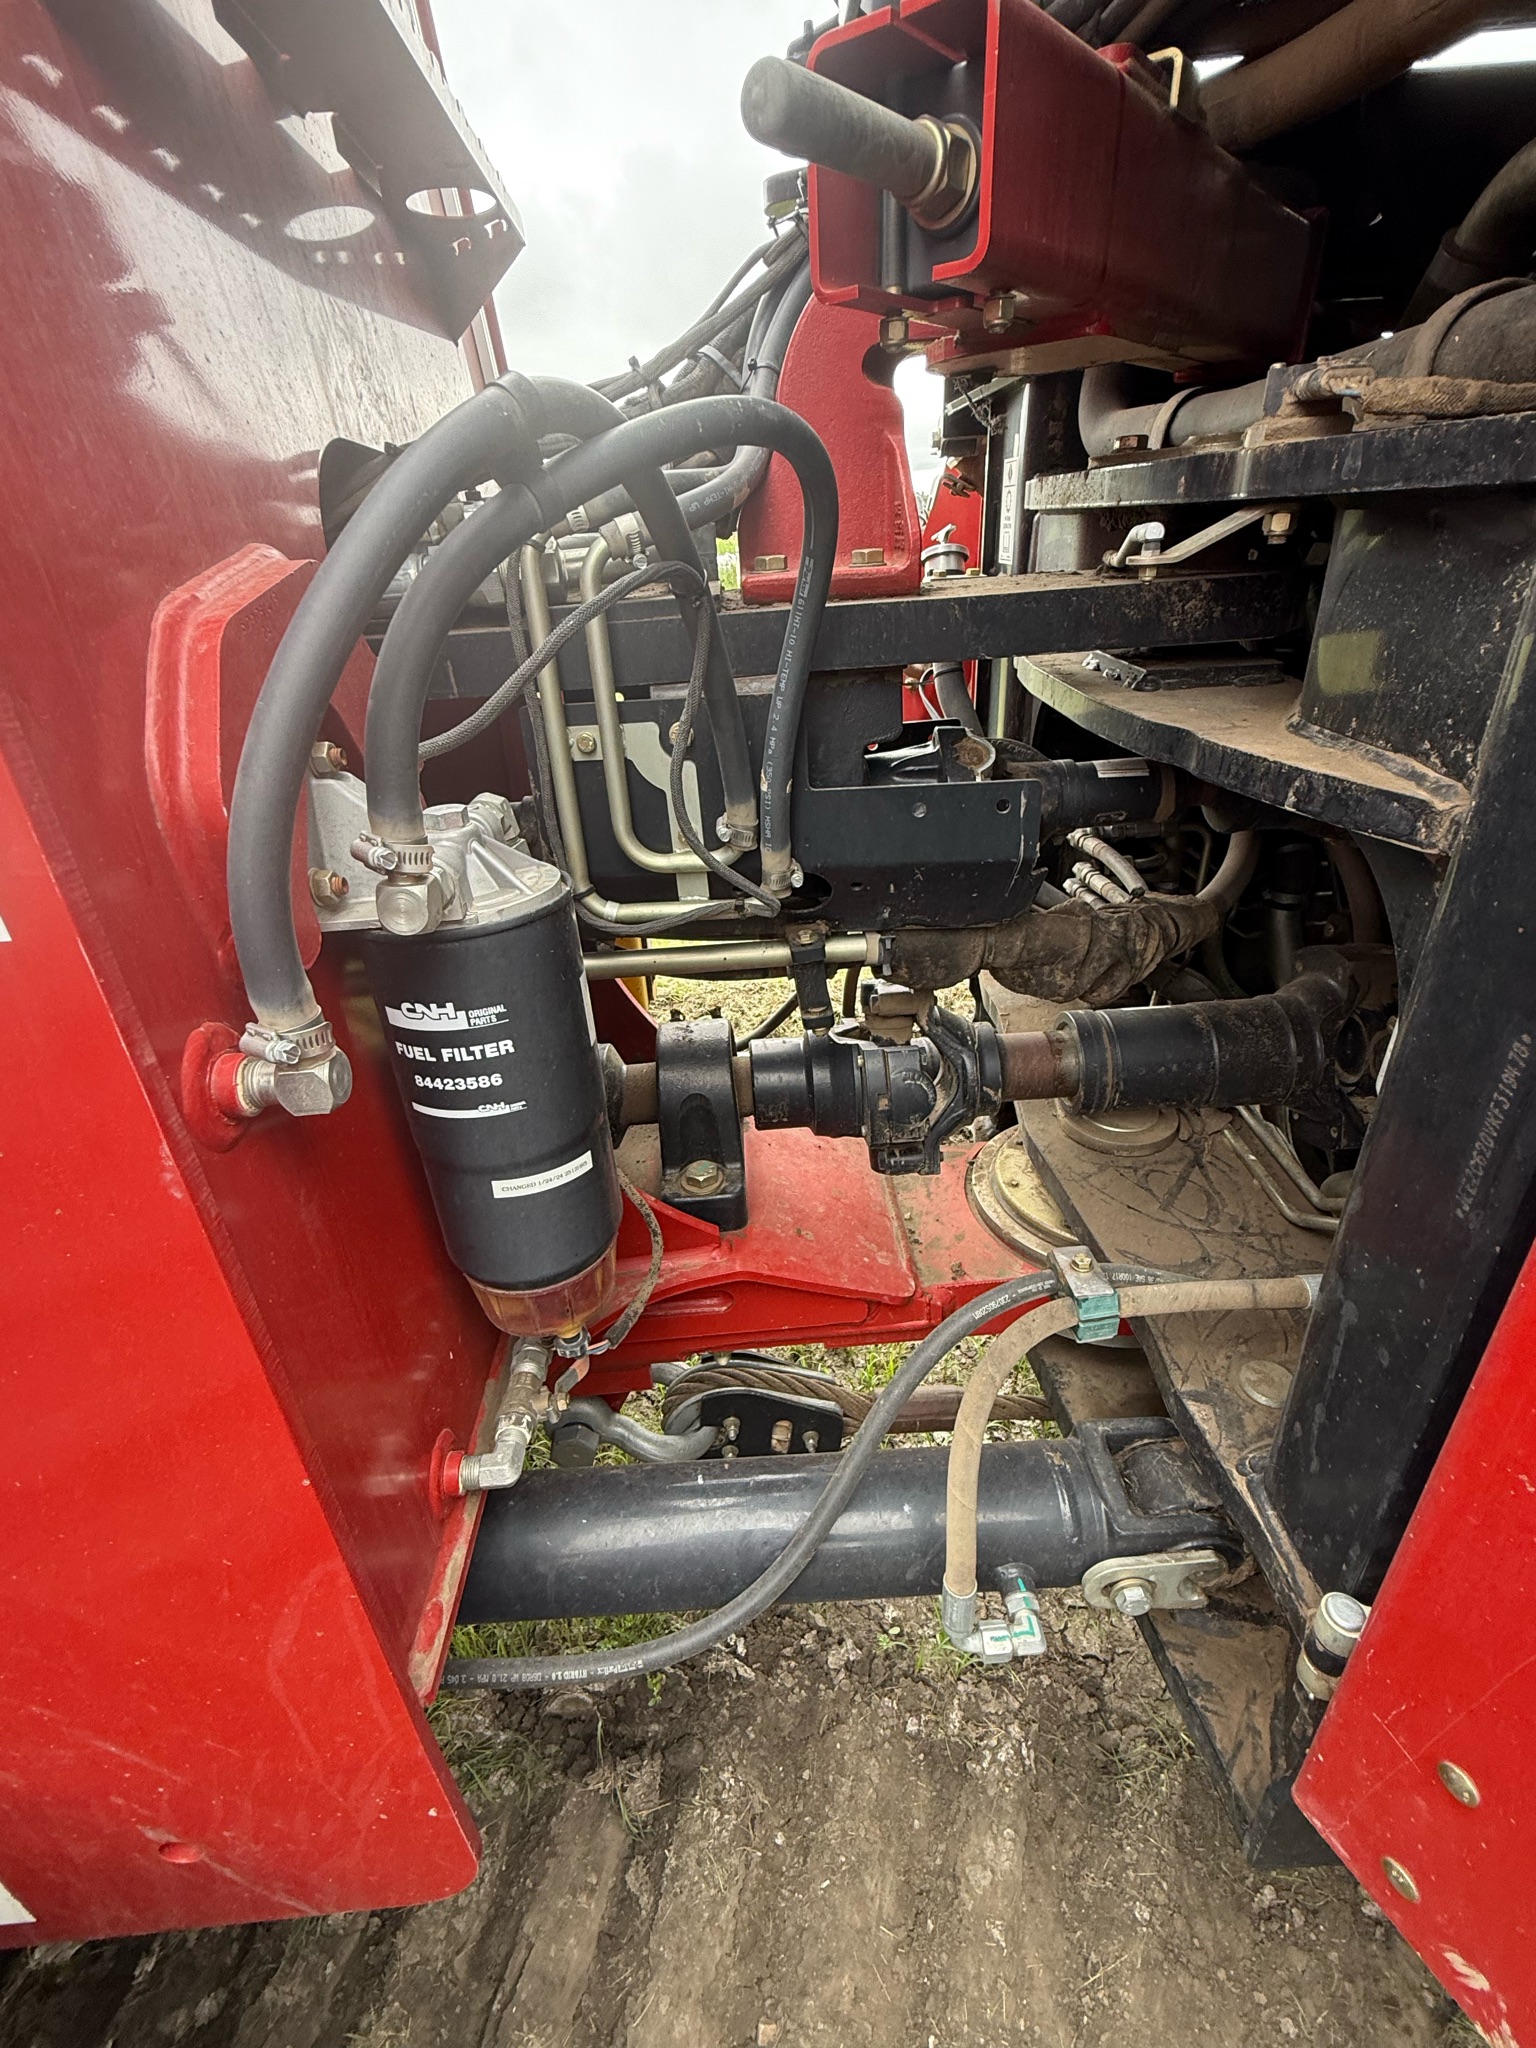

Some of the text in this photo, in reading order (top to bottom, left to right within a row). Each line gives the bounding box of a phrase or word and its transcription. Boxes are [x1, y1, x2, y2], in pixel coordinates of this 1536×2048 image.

[800, 558, 814, 598] Parker
[788, 598, 806, 646] 611HT-10
[779, 649, 794, 692] HI-TEMP
[771, 713, 780, 732] 2.4
[768, 736, 776, 755] MPa
[400, 1002, 456, 1020] CNH
[468, 1004, 507, 1019] ORIGINAL
[470, 1015, 497, 1027] PARTS
[395, 1039, 515, 1062] FUEL FILTER
[414, 1073, 503, 1091] 84423586
[478, 1101, 506, 1113] CNH
[501, 1182, 537, 1192] CHANGED
[538, 1174, 563, 1186] 1/24/24
